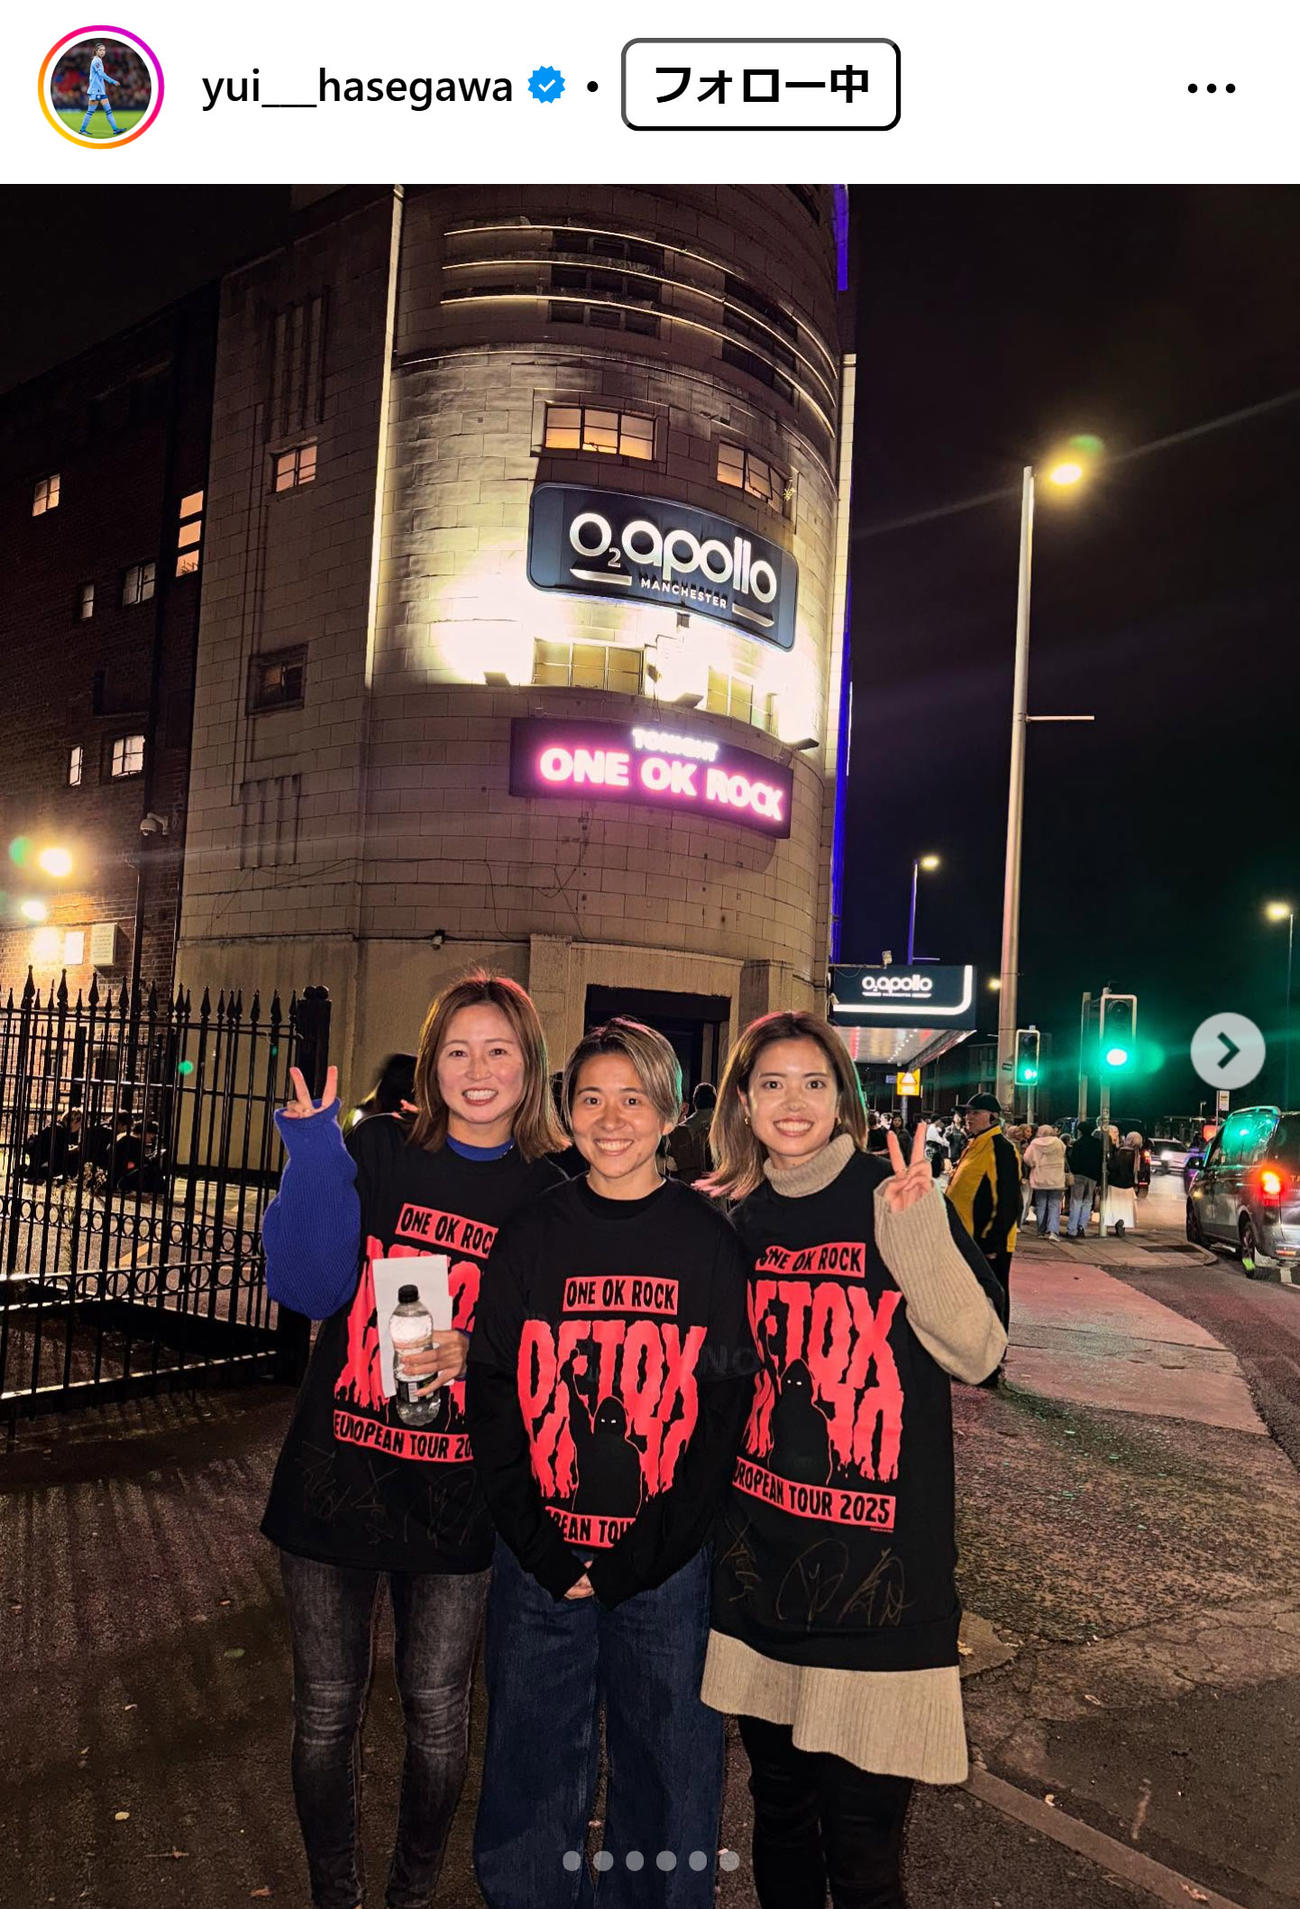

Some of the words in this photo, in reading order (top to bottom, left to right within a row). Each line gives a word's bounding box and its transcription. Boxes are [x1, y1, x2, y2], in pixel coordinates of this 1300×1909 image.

[621, 520, 777, 603] apollo
[641, 577, 727, 609] MANCHESTER
[539, 748, 630, 787] ONE
[640, 757, 697, 798] OK
[706, 767, 783, 821] ROCK
[401, 1208, 432, 1235] ONE
[435, 1216, 460, 1243] OK
[461, 1223, 494, 1255] ROC
[792, 1250, 815, 1271] OK
[818, 1247, 861, 1272] ROCK
[567, 1281, 595, 1308] ONE
[602, 1279, 625, 1307] OK
[632, 1281, 675, 1310] ROCK
[747, 1280, 902, 1432] ETOX
[517, 1319, 708, 1454] DETOX
[410, 1434, 449, 1459] TOUR
[455, 1437, 474, 1459] 20
[732, 1460, 784, 1506] UROPEAN
[789, 1485, 832, 1517] TOUR
[840, 1494, 890, 1525] 2025
